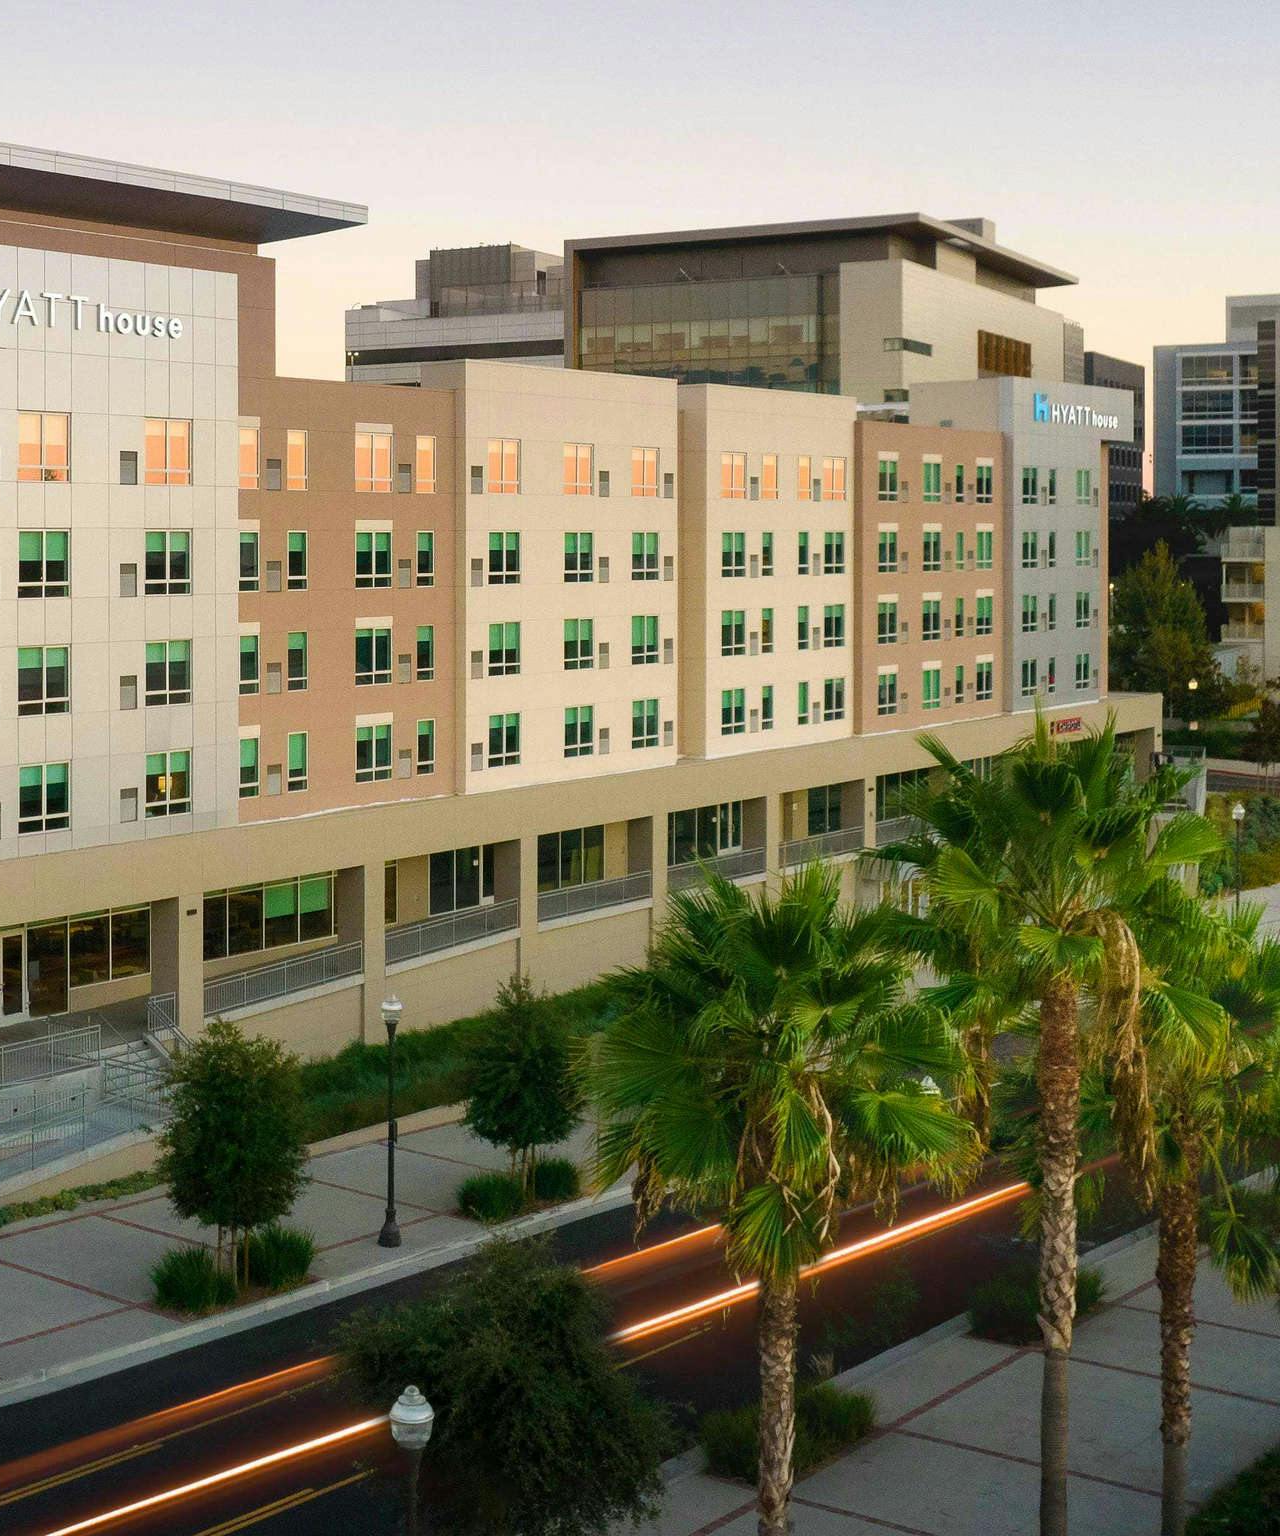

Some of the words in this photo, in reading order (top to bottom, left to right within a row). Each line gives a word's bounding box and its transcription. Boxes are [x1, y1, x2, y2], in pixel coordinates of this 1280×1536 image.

[96, 303, 184, 339] house
[1051, 403, 1091, 426] HYATT
[1091, 410, 1119, 429] house
